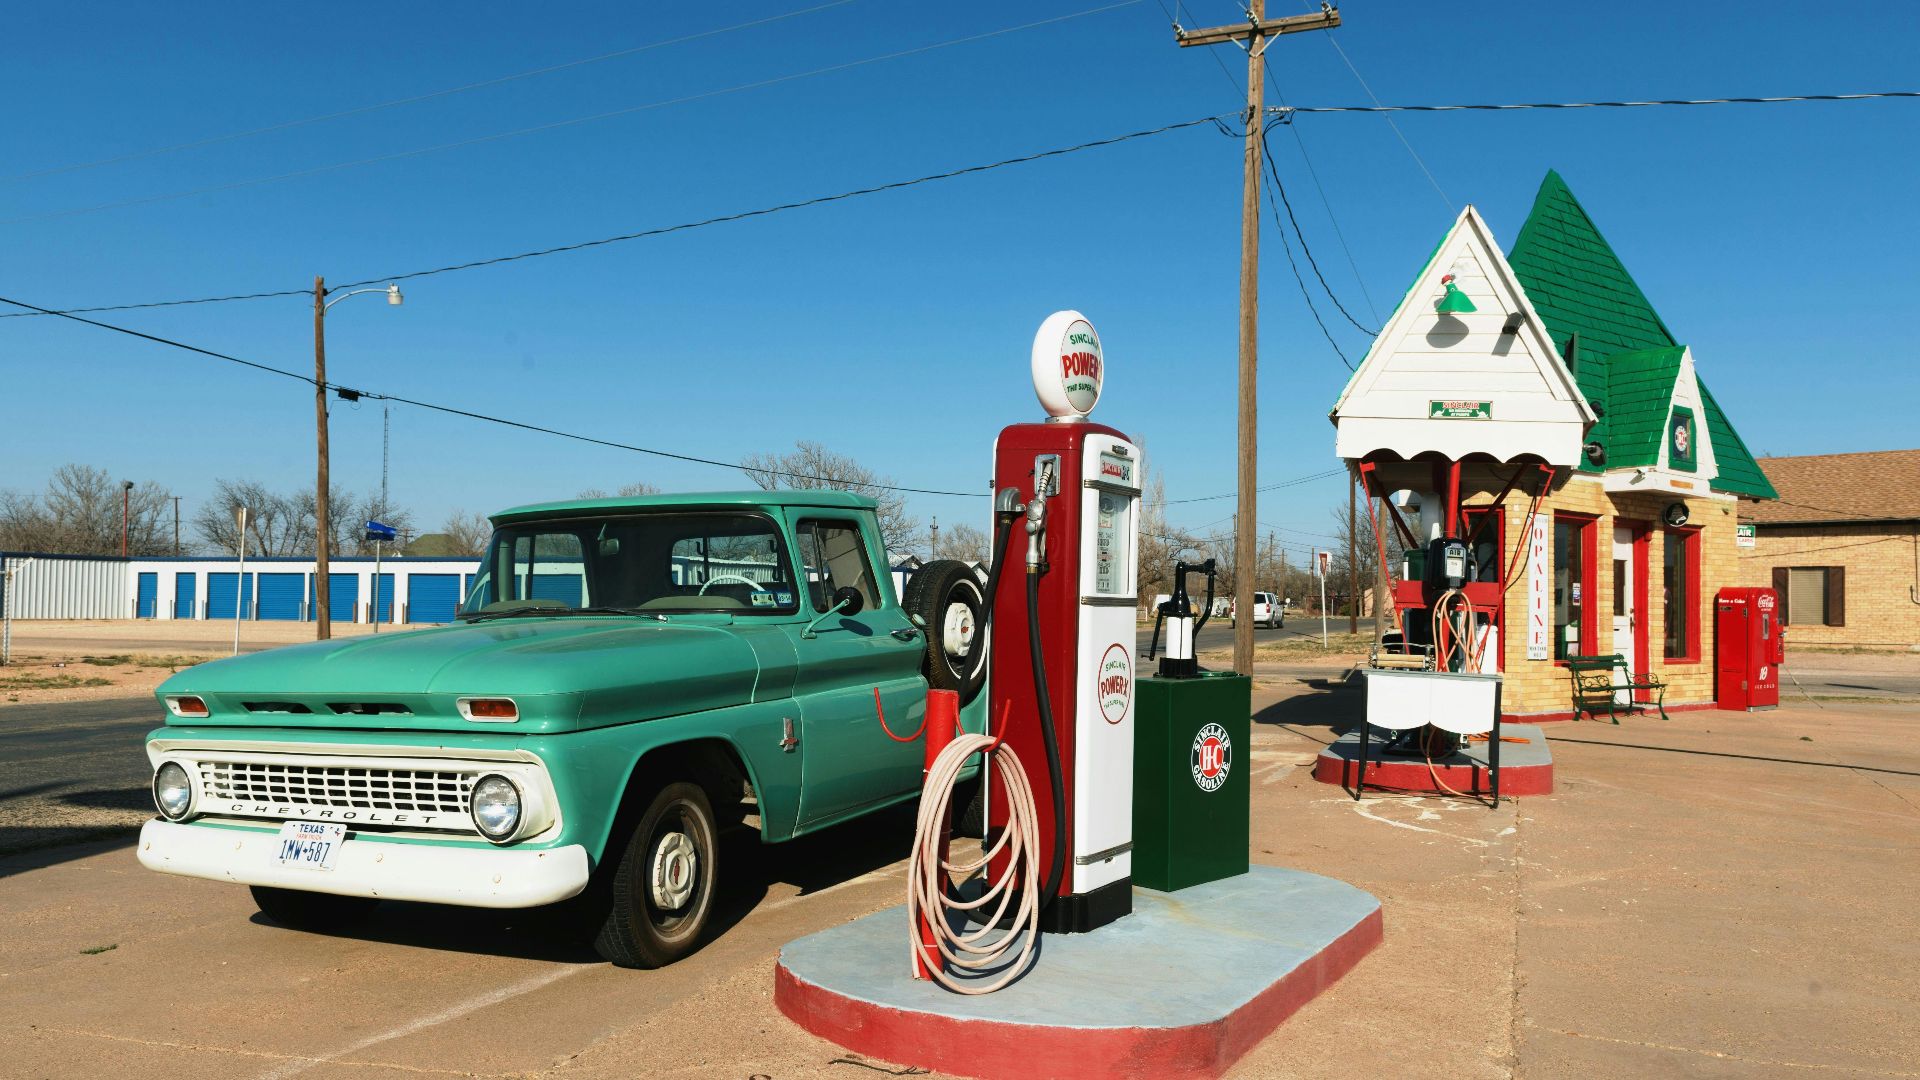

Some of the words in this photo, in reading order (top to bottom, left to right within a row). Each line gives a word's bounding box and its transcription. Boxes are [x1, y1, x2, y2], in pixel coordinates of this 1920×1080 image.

[1067, 384, 1077, 392] THE
[1442, 401, 1480, 409] SINCLAIR
[1534, 527, 1544, 645] OPALINE
[1105, 660, 1126, 672] SINCLAIR
[1194, 725, 1231, 752] SINCLAIR
[1193, 761, 1230, 789] GASOLINE
[231, 804, 437, 823] CHEVROLET
[299, 824, 325, 834] TEXAS
